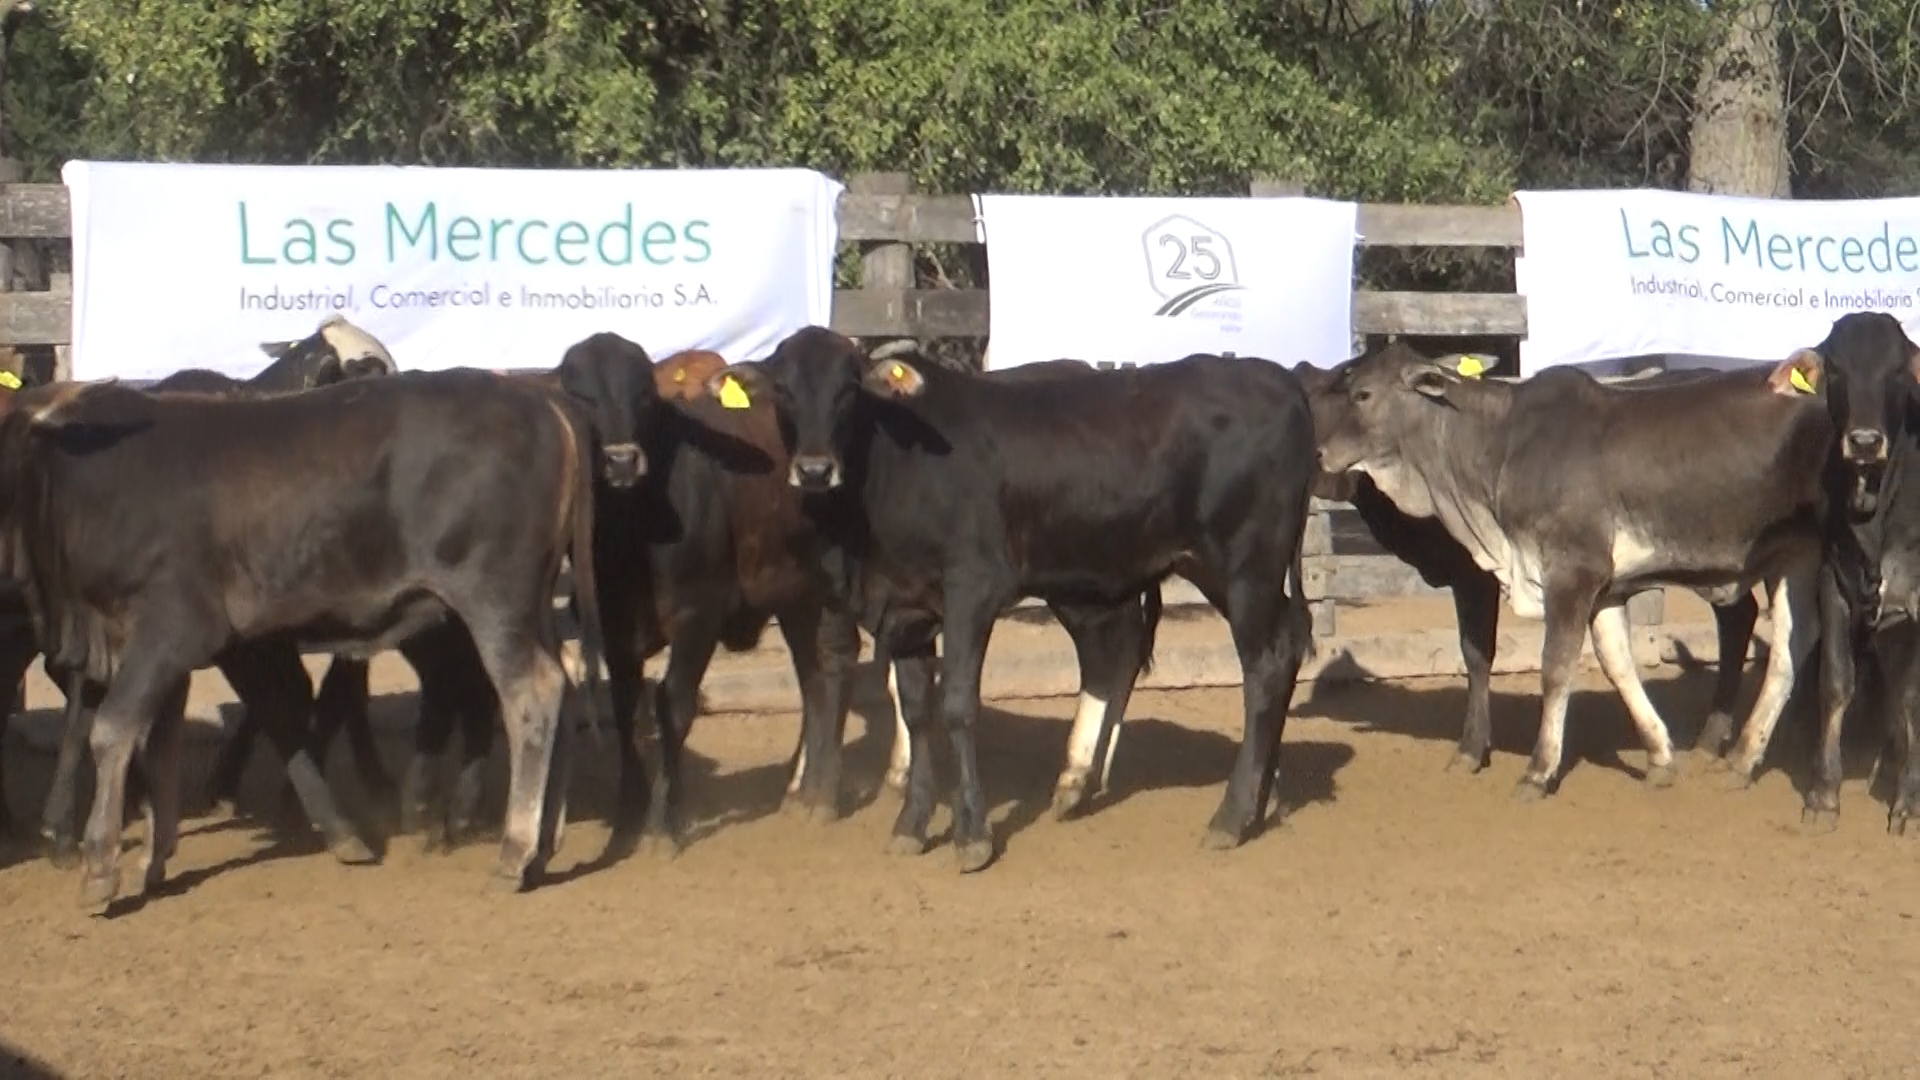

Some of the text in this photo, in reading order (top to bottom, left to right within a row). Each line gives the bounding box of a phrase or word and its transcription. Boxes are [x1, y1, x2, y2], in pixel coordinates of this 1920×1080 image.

[238, 200, 712, 267] Las Mercedes
[1159, 233, 1221, 281] 25
[1620, 207, 1919, 274] Las Mercede
[240, 282, 718, 312] Industrial, Comercial e Inmobiliaria S.A.
[1710, 282, 1803, 307] Comercial
[1809, 294, 1820, 309] e
[1824, 288, 1913, 309] Inmobiliaria
